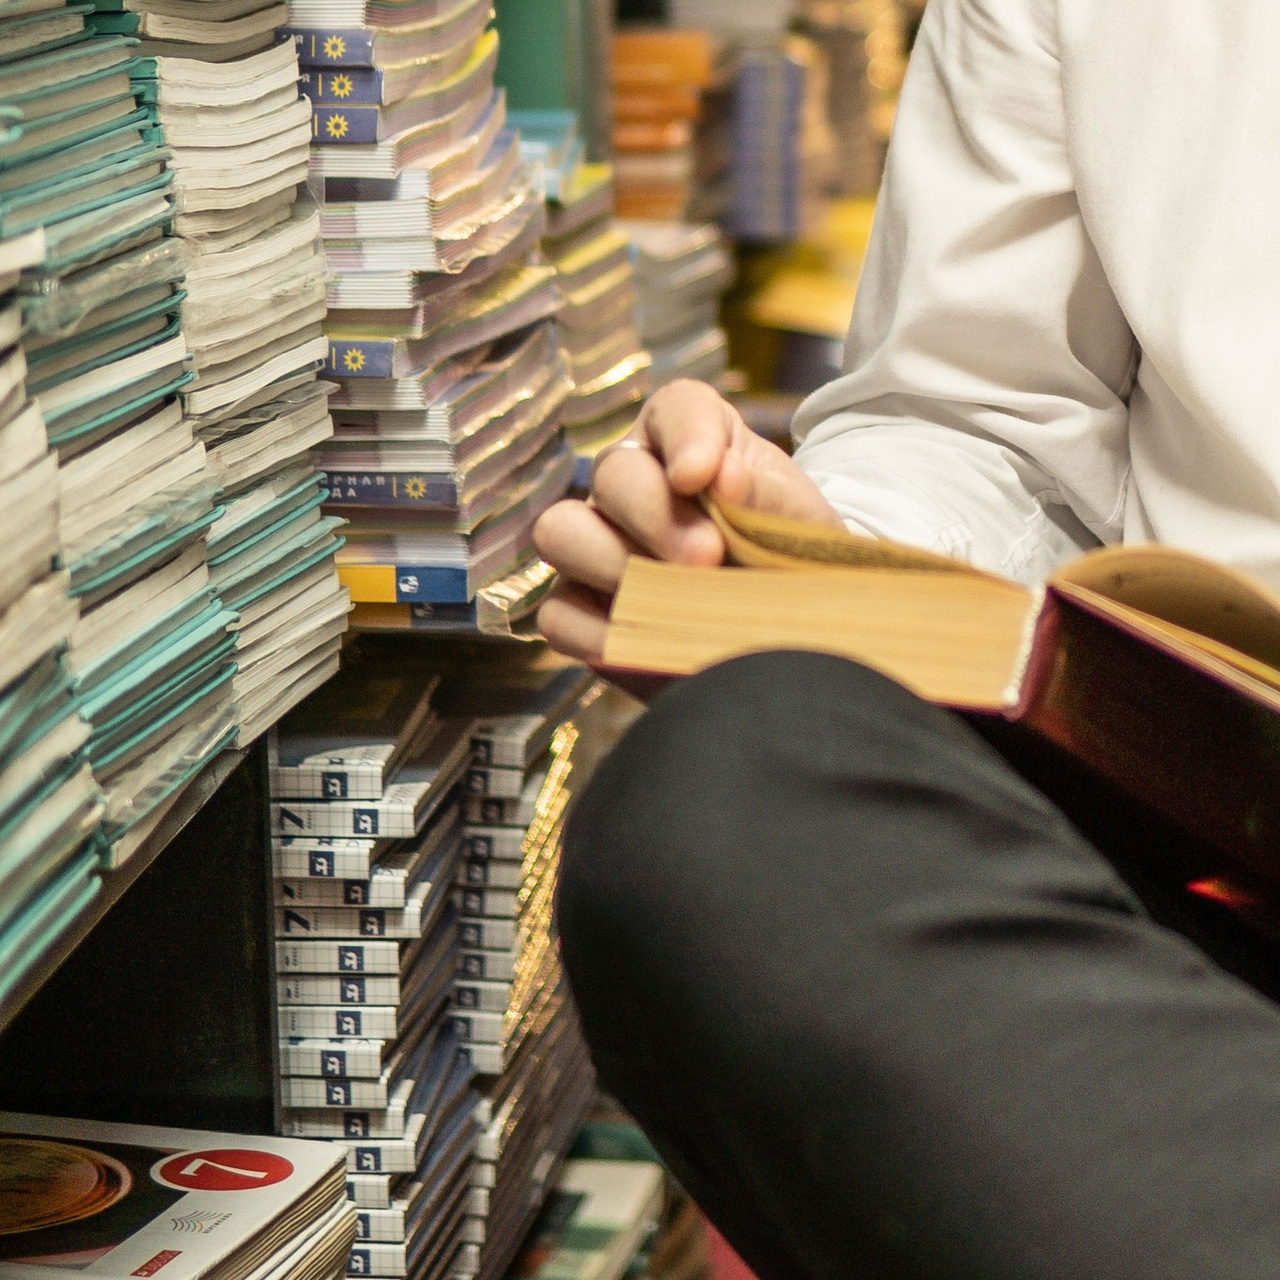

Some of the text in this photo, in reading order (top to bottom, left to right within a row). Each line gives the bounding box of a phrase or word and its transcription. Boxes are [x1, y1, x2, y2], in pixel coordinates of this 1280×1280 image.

[279, 806, 305, 831] 7
[284, 909, 310, 933] 7
[180, 1158, 269, 1179] 7
